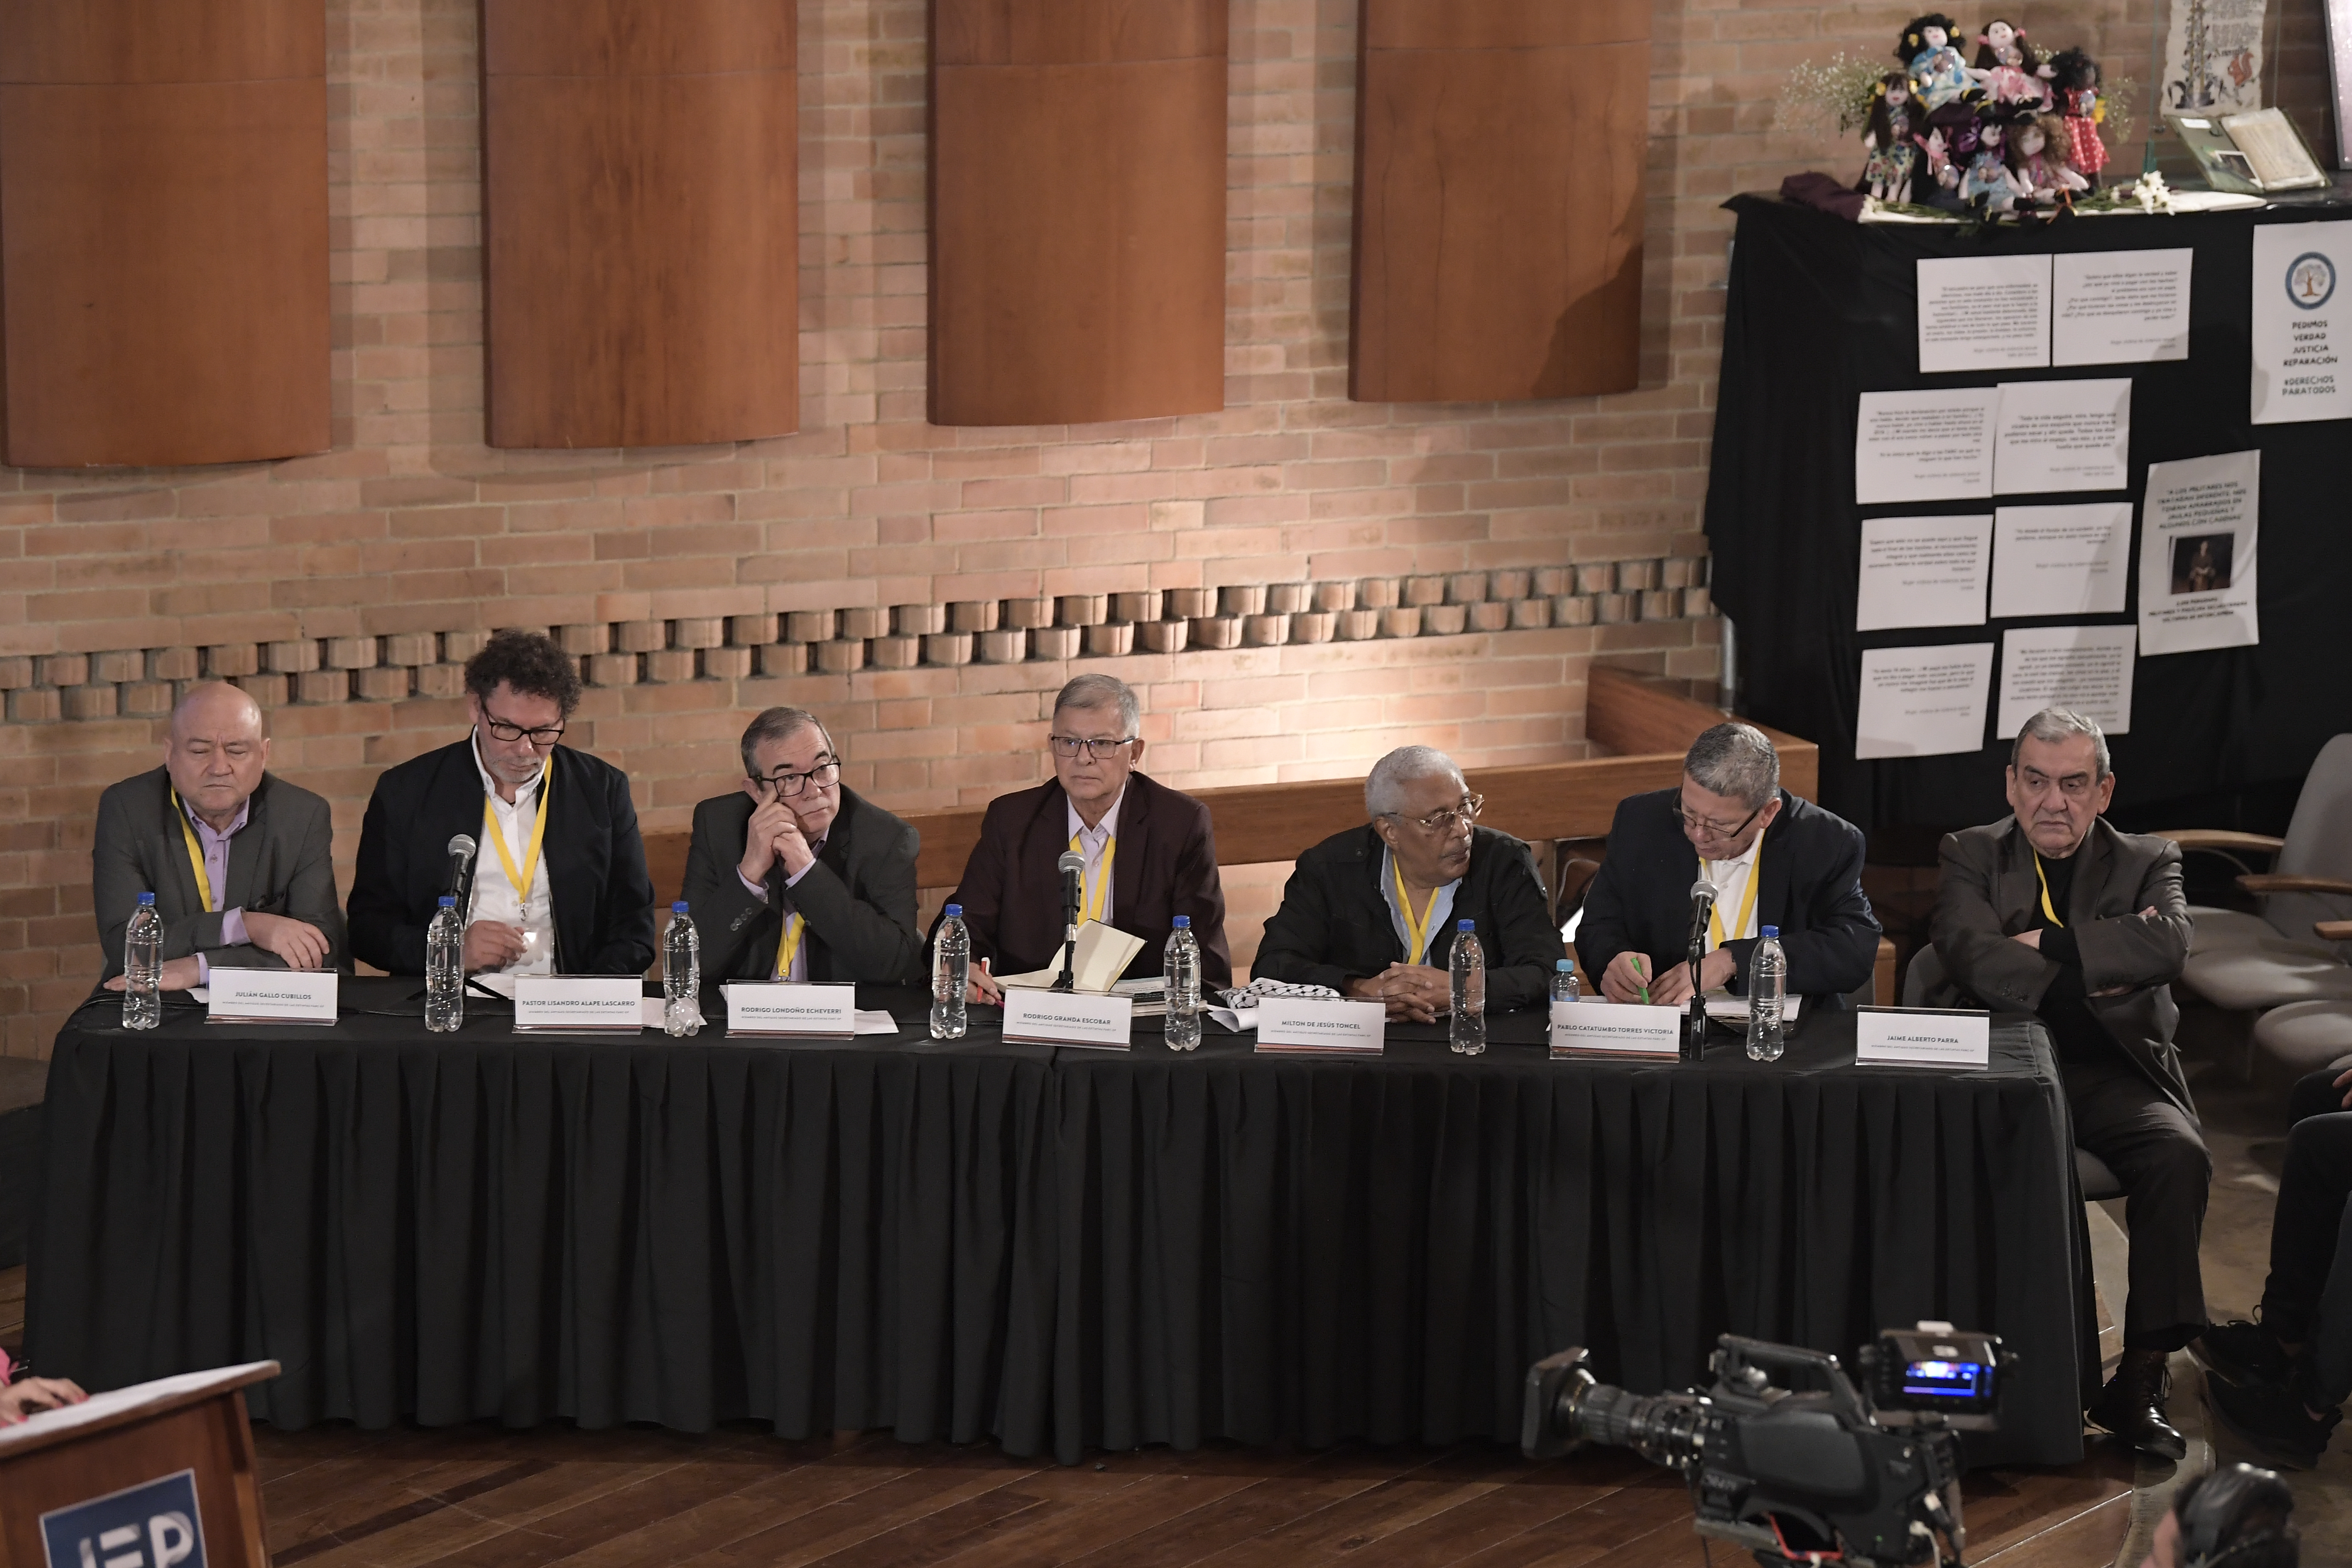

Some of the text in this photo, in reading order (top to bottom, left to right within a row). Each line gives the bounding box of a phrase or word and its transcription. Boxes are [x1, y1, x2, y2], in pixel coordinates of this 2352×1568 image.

[2292, 321, 2328, 329] PEDIMOS
[2294, 332, 2326, 341] VERDAD
[2293, 345, 2329, 354] JUSTICIA
[2283, 357, 2338, 366] REPARACIÓN
[2282, 386, 2336, 396] PARATODOS
